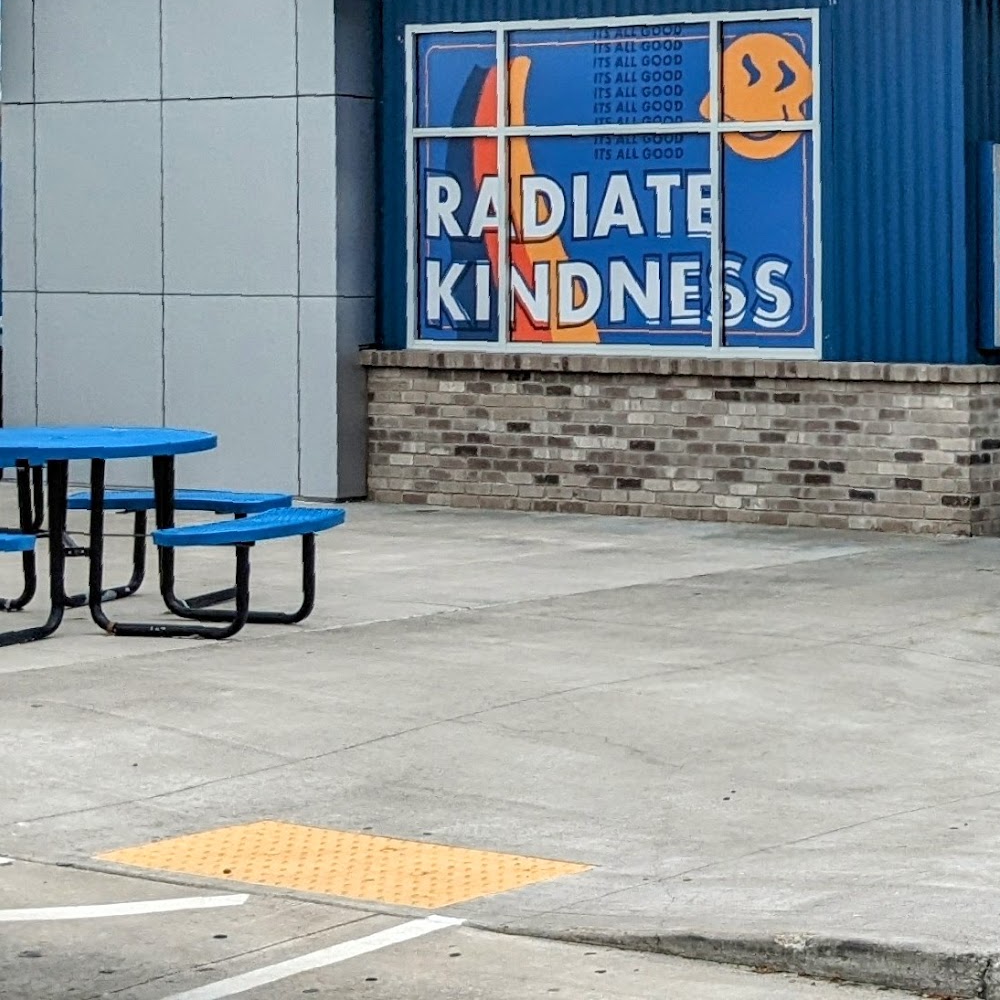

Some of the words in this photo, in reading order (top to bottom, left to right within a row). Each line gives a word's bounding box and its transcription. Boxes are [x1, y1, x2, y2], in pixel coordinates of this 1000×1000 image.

[593, 57, 611, 69] ITS
[614, 56, 637, 68] ALL
[641, 54, 683, 66] GOOD
[593, 72, 612, 84] ITS
[614, 71, 638, 83] ALL
[641, 70, 683, 82] GOOD
[593, 87, 611, 99] ITS
[615, 86, 637, 98] ALL
[642, 84, 684, 97] GOOD
[593, 102, 611, 114] ITS
[615, 101, 638, 113] ALL
[642, 100, 684, 113] GOOD
[593, 148, 612, 160] ITS
[616, 147, 639, 160] ALL
[642, 146, 684, 160] GOOD
[425, 171, 712, 240] RADIATE
[425, 259, 794, 329] KINDNESS
